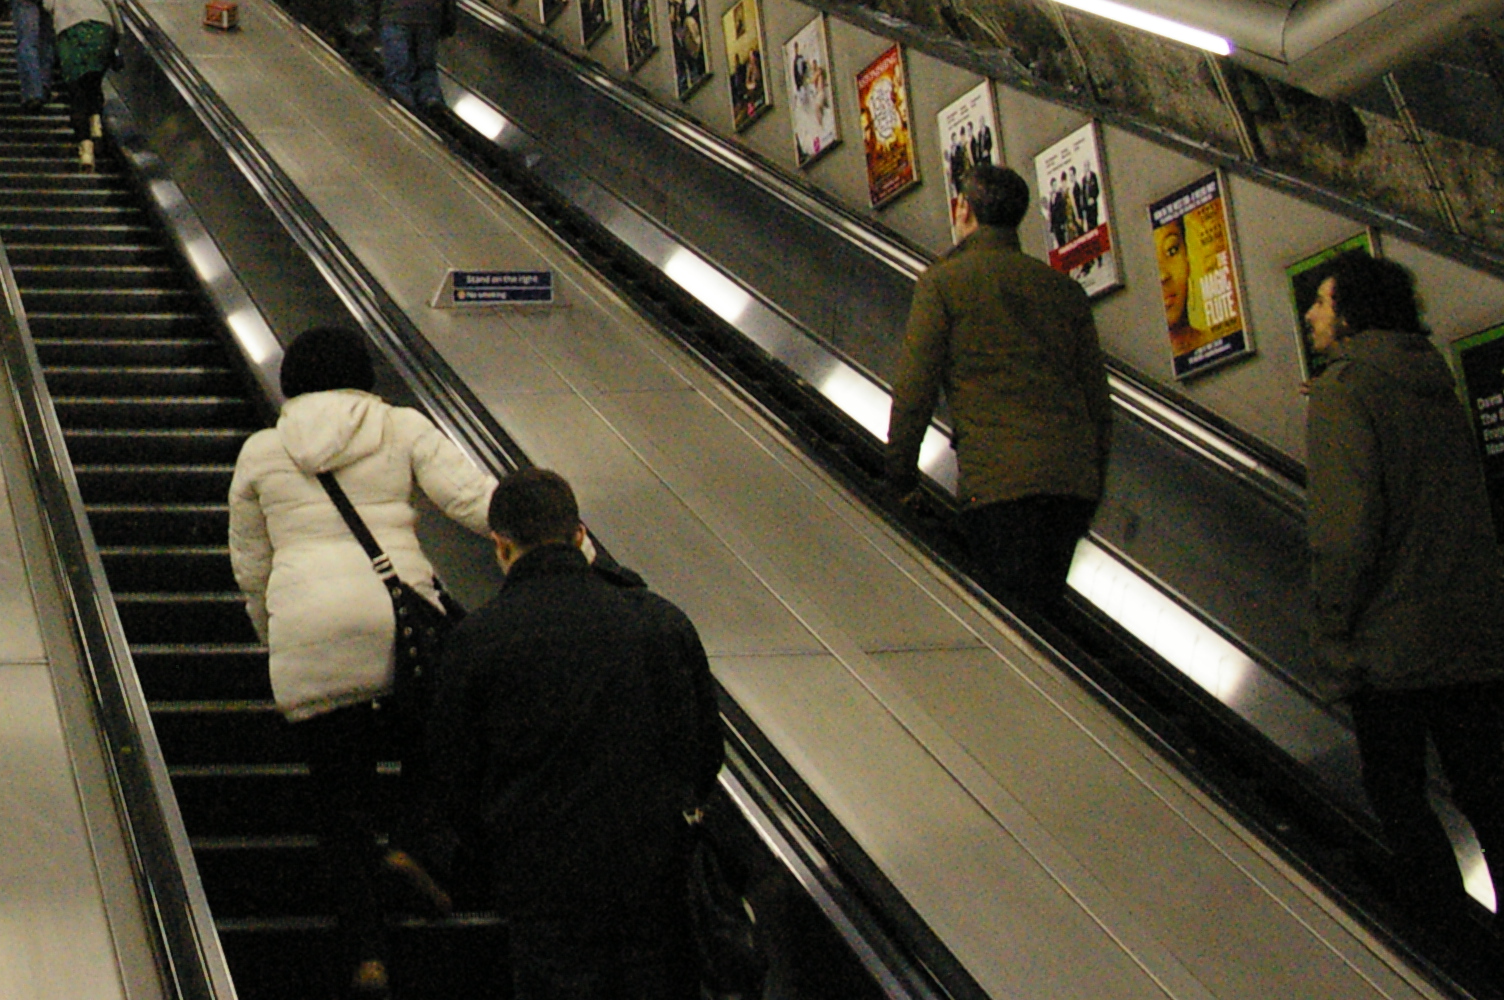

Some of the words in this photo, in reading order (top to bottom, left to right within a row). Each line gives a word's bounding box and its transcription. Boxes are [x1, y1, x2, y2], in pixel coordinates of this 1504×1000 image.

[467, 275, 490, 284] Stand
[502, 275, 517, 284] the
[518, 275, 538, 285] right
[478, 291, 507, 300] smoking
[1205, 292, 1237, 327] FLUTE
